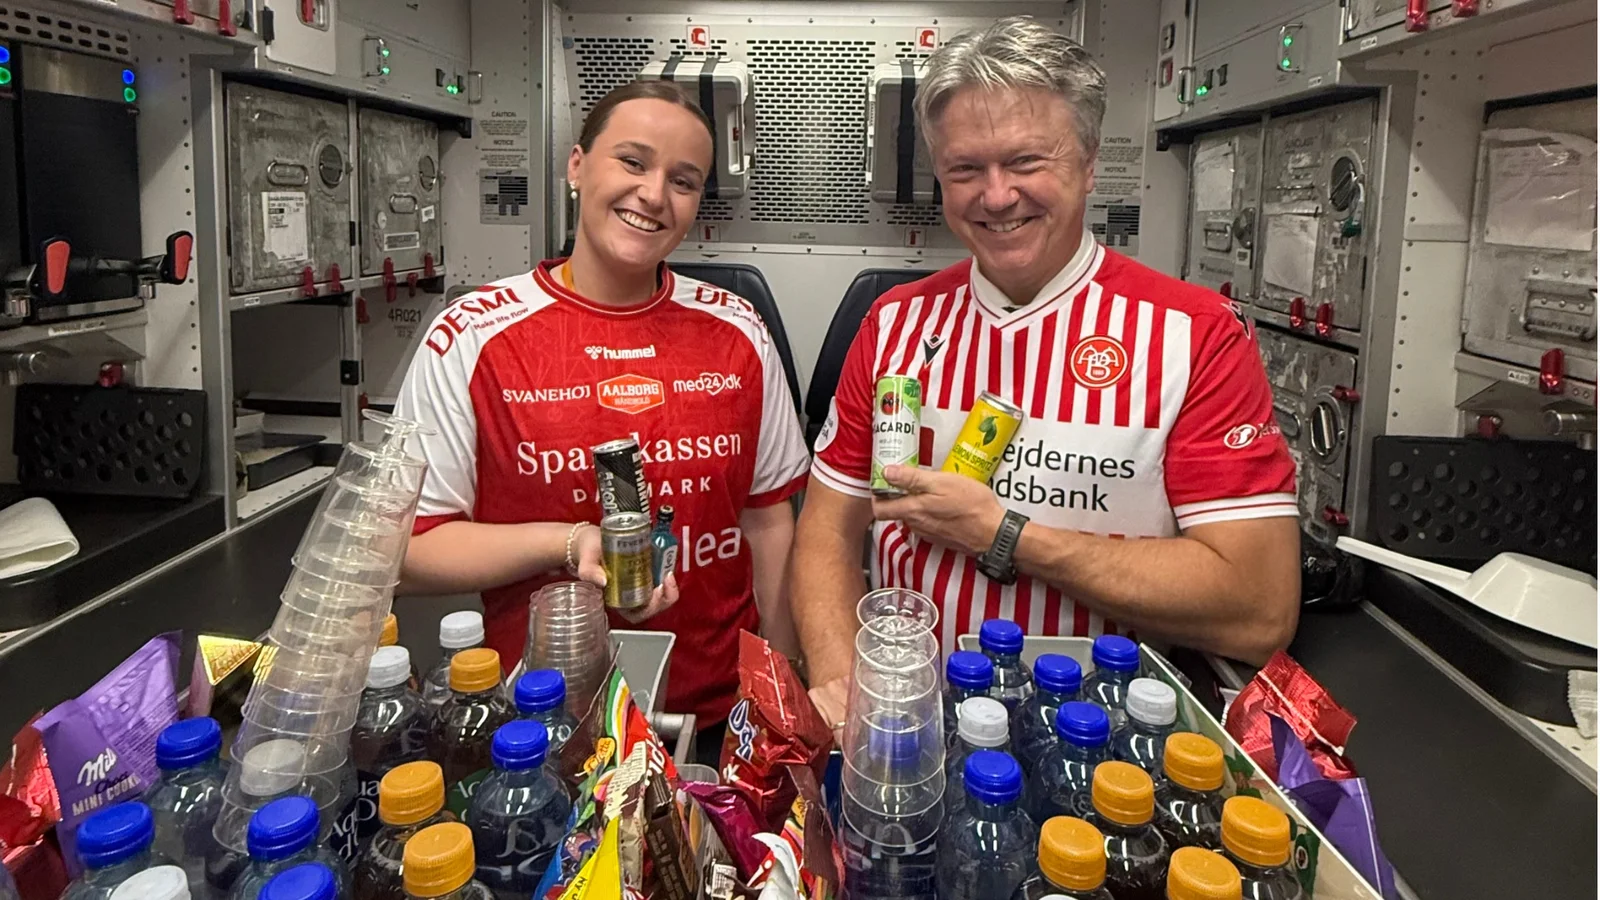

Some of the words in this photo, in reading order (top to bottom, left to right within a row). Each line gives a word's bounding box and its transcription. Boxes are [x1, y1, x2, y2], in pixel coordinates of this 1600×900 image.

[387, 308, 422, 323] 4R021
[425, 287, 524, 358] DESMI
[495, 314, 511, 326] life
[603, 345, 656, 360] hummel
[502, 385, 591, 403] SVANEHØJ
[602, 384, 660, 397] AALBORG
[873, 421, 916, 436] ACARDÍ
[517, 431, 742, 484] Spakassen
[1002, 437, 1135, 479] ejdernes
[571, 476, 712, 504] DARK
[988, 471, 1109, 512] dsbank
[682, 525, 742, 572] lea
